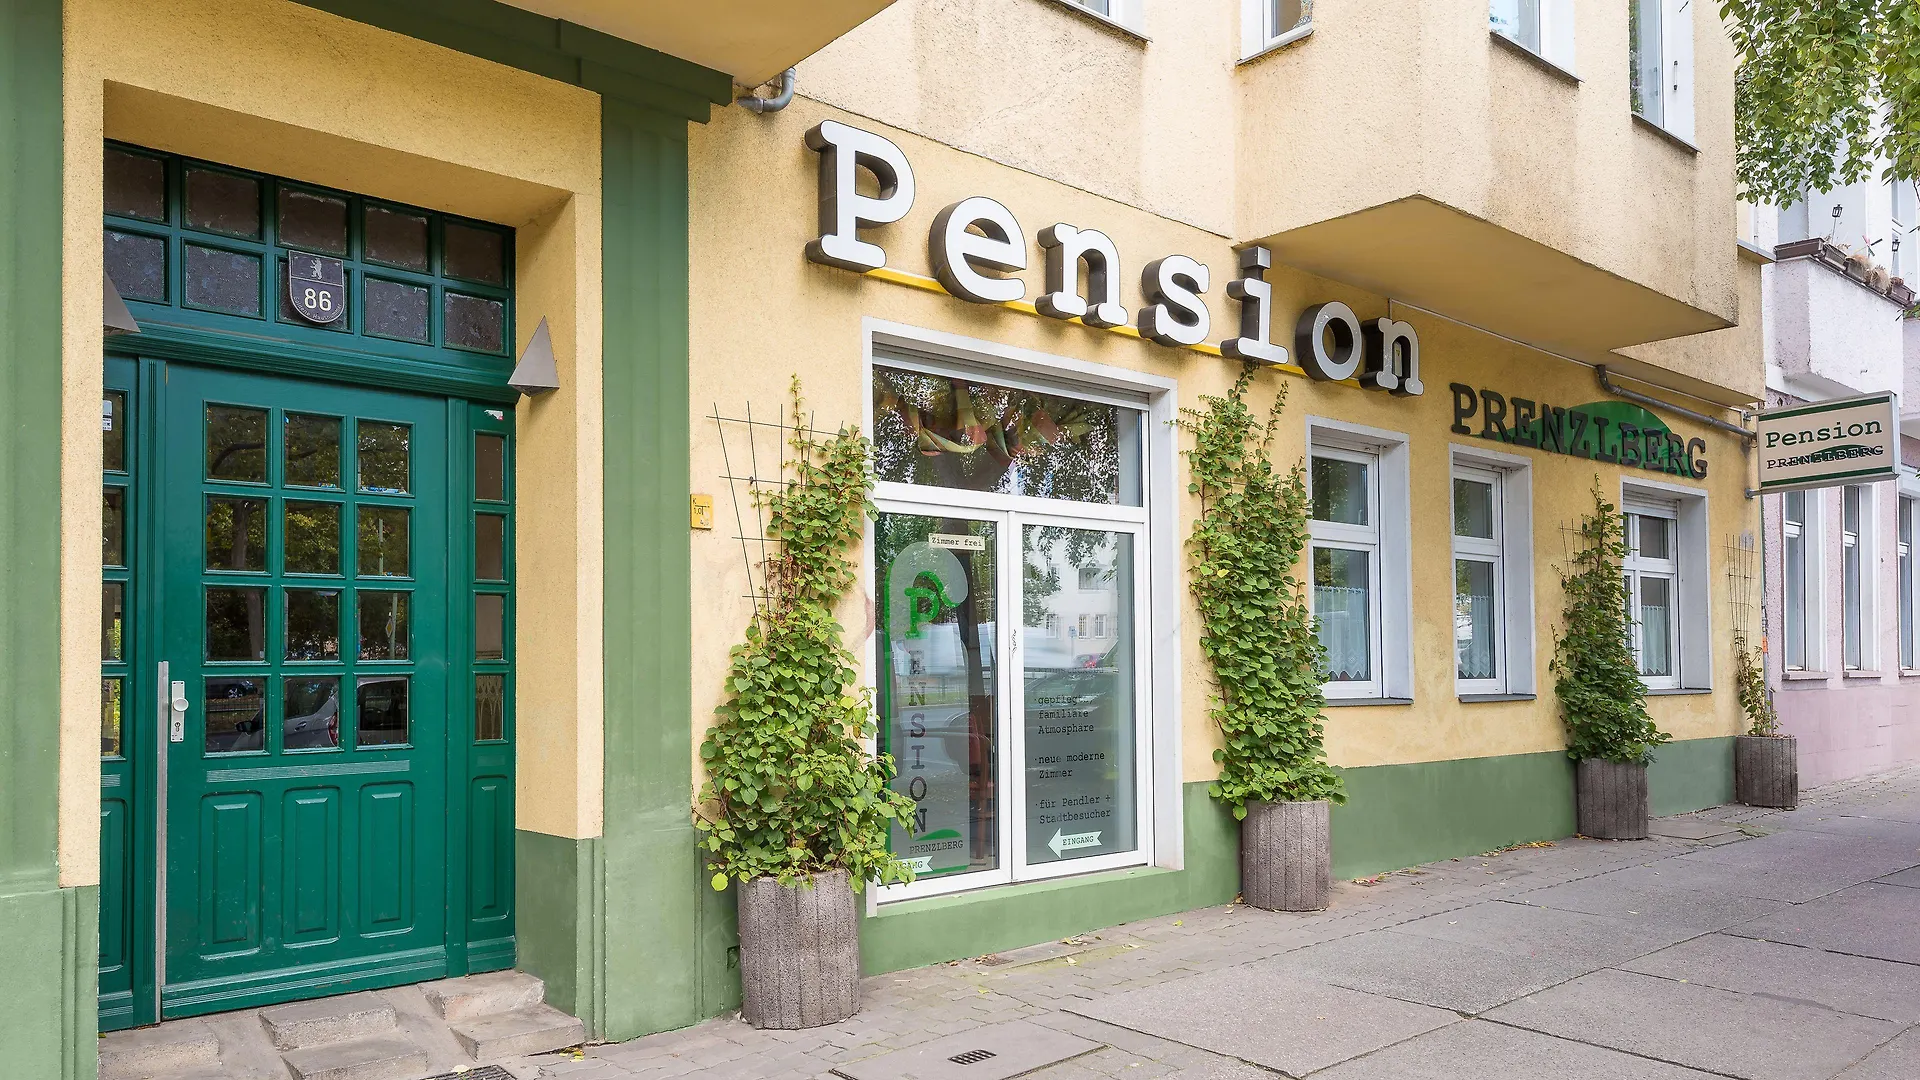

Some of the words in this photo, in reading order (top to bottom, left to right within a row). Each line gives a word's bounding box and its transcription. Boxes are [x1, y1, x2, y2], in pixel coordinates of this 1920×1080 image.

[804, 119, 1425, 397] Pension
[304, 287, 332, 312] 86
[1449, 382, 1708, 480] PRENZLBERG
[1765, 420, 1883, 449] Pension
[1766, 445, 1884, 469] PRENZLBERG
[931, 536, 959, 546] Zimmer
[964, 538, 982, 547] frei
[1038, 723, 1094, 736] Atmosphäre
[1039, 755, 1061, 764] neue
[1066, 752, 1105, 762] moderne
[1039, 769, 1073, 779] Zimmer
[1039, 799, 1056, 809] für
[1062, 795, 1100, 807] Pendler
[1039, 808, 1111, 825] Stadtbesucher
[909, 840, 963, 854] PRENZLBERG
[1062, 835, 1094, 846] EINGANG
